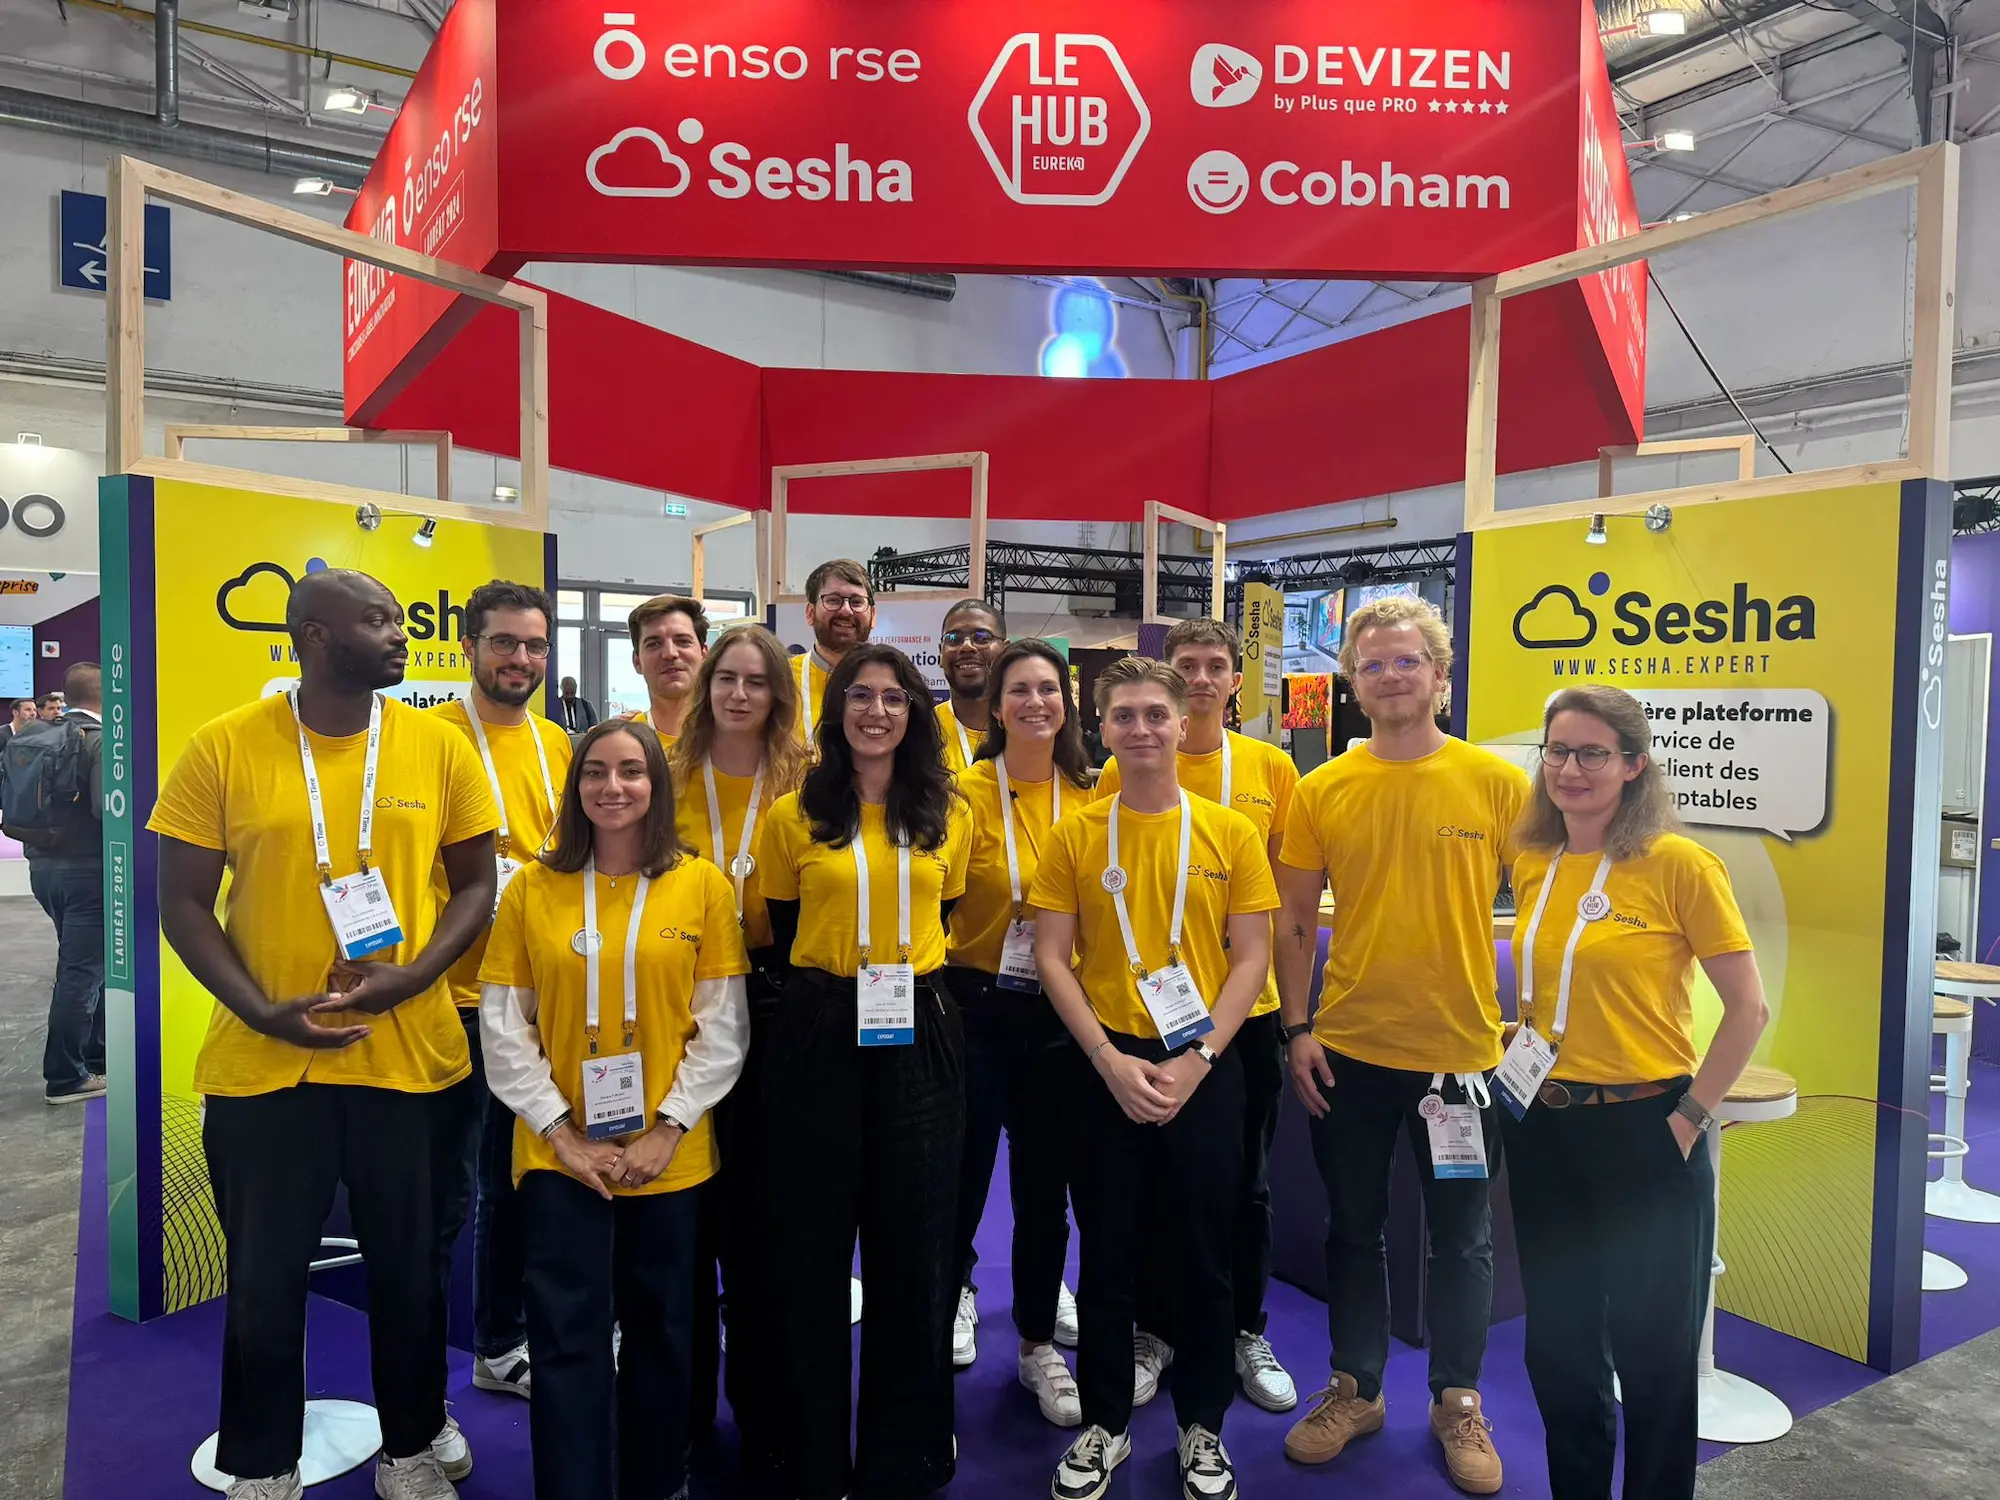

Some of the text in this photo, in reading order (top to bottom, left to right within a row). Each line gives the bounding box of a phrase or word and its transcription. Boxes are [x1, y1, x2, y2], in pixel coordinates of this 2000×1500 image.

[664, 42, 808, 80] enso
[829, 46, 921, 82] rse
[1028, 32, 1079, 86] LE
[1274, 45, 1511, 91] DEVIZEN
[1011, 95, 1108, 146] HUB
[1274, 95, 1418, 115] by Plus que PRO
[708, 142, 914, 203] Sesha
[1260, 160, 1511, 209] Cobham
[0, 579, 40, 595] prise
[1249, 601, 1260, 639] Sesha
[1612, 582, 1816, 646] Sesha
[1929, 559, 1947, 667] Sesha
[111, 642, 124, 694] rse
[1553, 655, 1770, 676] WWW.SESHA.EXPERT
[1682, 701, 1813, 724] plateforme
[112, 704, 125, 781] enso
[1650, 731, 1735, 750] rvice de
[1720, 760, 1759, 781] des
[397, 799, 426, 810] Sesha
[1458, 829, 1485, 840] Sesha
[113, 856, 124, 966] LAURÉAT 2024
[1613, 912, 1648, 929] Sesha
